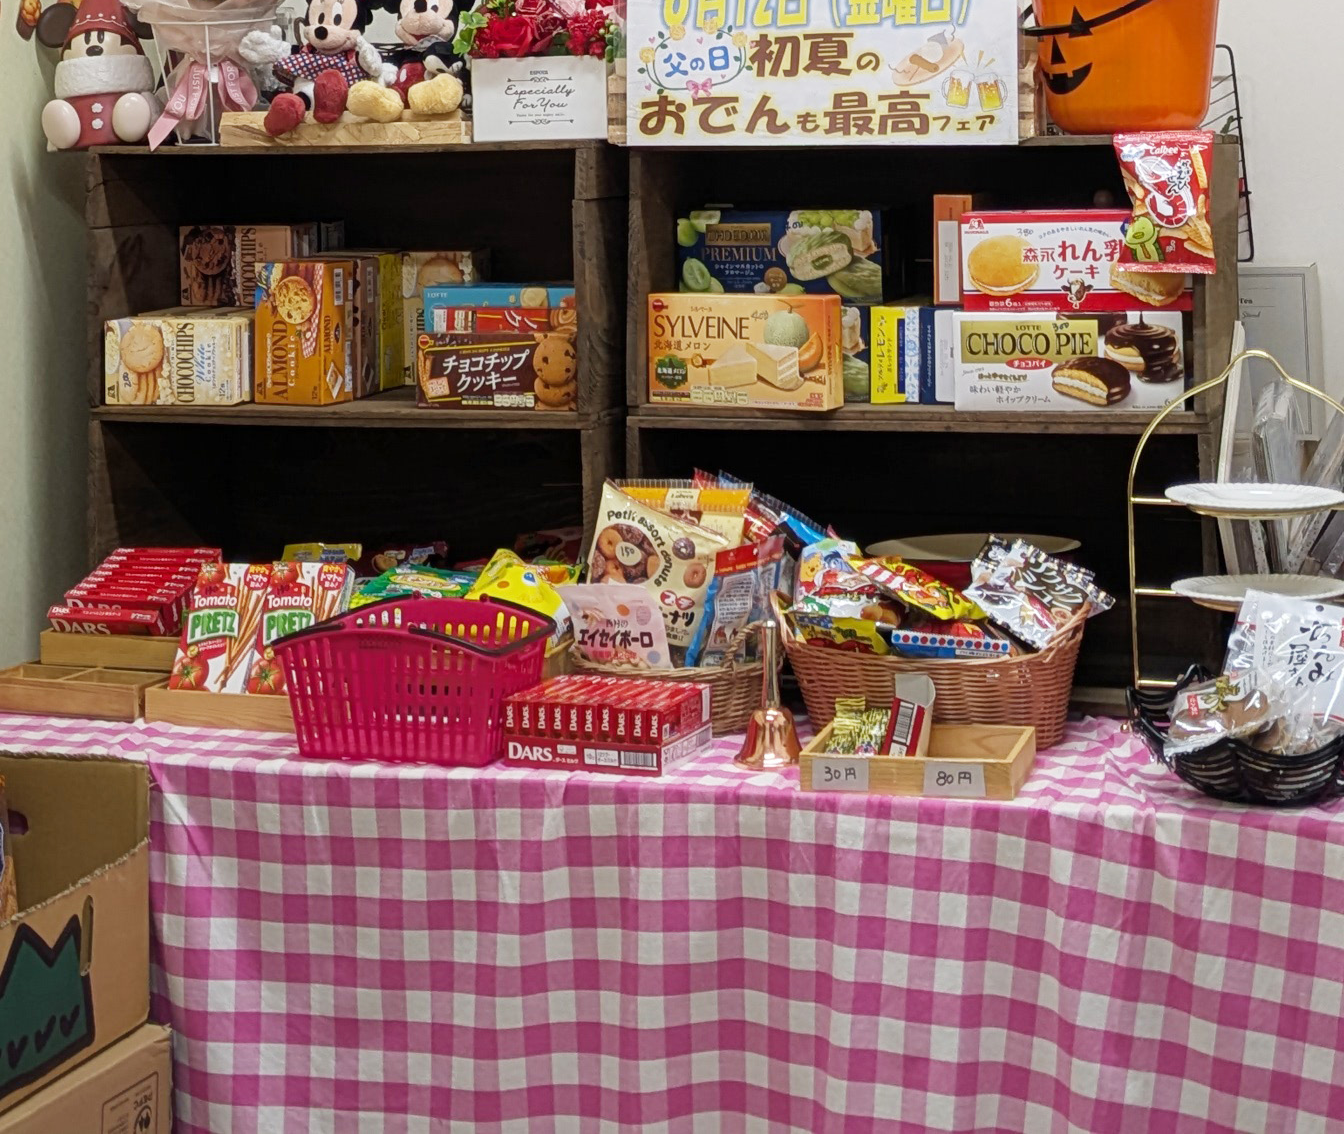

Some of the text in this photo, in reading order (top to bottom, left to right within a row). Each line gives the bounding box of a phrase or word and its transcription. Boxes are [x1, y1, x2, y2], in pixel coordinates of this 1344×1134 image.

[662, 45, 731, 78] 父の日
[504, 83, 576, 99] Especially
[1149, 145, 1179, 156] Calbee
[702, 246, 777, 262] PREMIUM
[1053, 264, 1101, 280] ケーキ
[323, 315, 333, 354] ALMOND
[653, 314, 750, 341] SYLVEINE
[653, 339, 712, 352] 北海道メロン
[965, 332, 1094, 356] CHOCO PIE
[175, 322, 196, 404] CHOCOCHIPS
[195, 343, 206, 386] White
[205, 343, 213, 383] Cookie
[271, 319, 289, 401] ALMOND
[288, 335, 297, 387] Cookie
[442, 348, 531, 375] チョコチップ
[1012, 359, 1047, 369] チョコパイ
[456, 371, 518, 393] クッキー
[996, 394, 1052, 404] ホイップクリーム
[193, 594, 238, 608] Tomato
[266, 594, 313, 608] Tomato
[50, 617, 112, 635] DARS
[189, 610, 237, 640] PRETZ
[577, 628, 654, 649] エイセイボーロ
[505, 702, 514, 728] DARS
[521, 704, 530, 729] DARS
[537, 705, 546, 729] DARS
[553, 705, 562, 730] DARS
[569, 706, 577, 731] DARS
[584, 707, 593, 732] DARS
[601, 706, 609, 731] DARS
[617, 711, 625, 736] DARS
[633, 713, 642, 737] DARS
[650, 714, 659, 738] DARS
[508, 741, 553, 762] DARS
[823, 765, 857, 782] 30円
[935, 770, 973, 787] 80円
